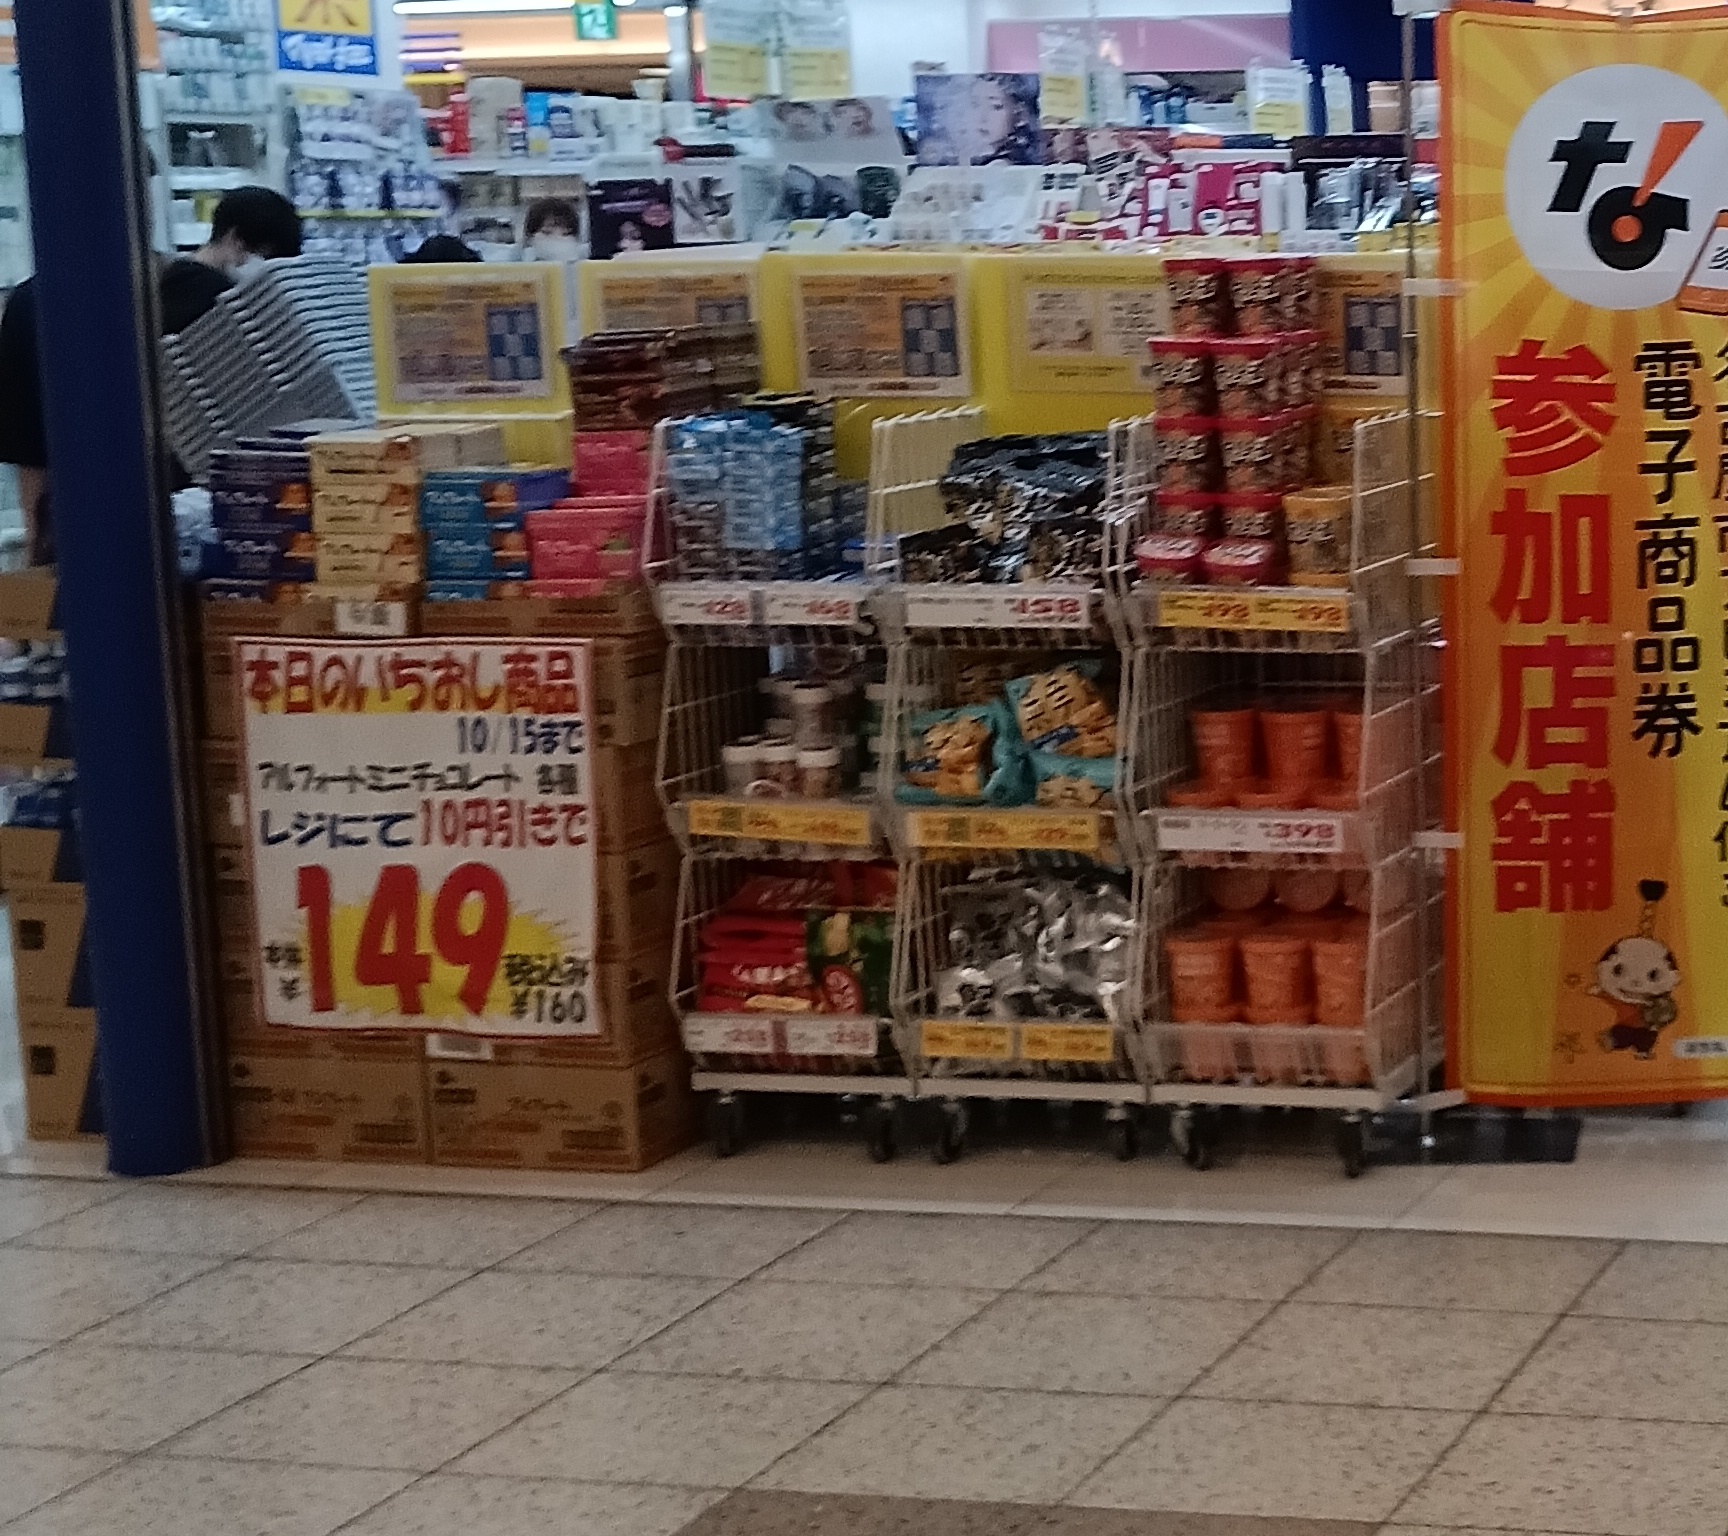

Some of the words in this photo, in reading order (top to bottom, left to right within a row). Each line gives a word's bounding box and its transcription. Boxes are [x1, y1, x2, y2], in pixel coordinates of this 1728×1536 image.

[246, 648, 579, 714] 本日のいちおし商品
[1490, 338, 1619, 914] 参加店舗
[1632, 339, 1706, 759] 電子商品券
[297, 861, 508, 1015] 149
